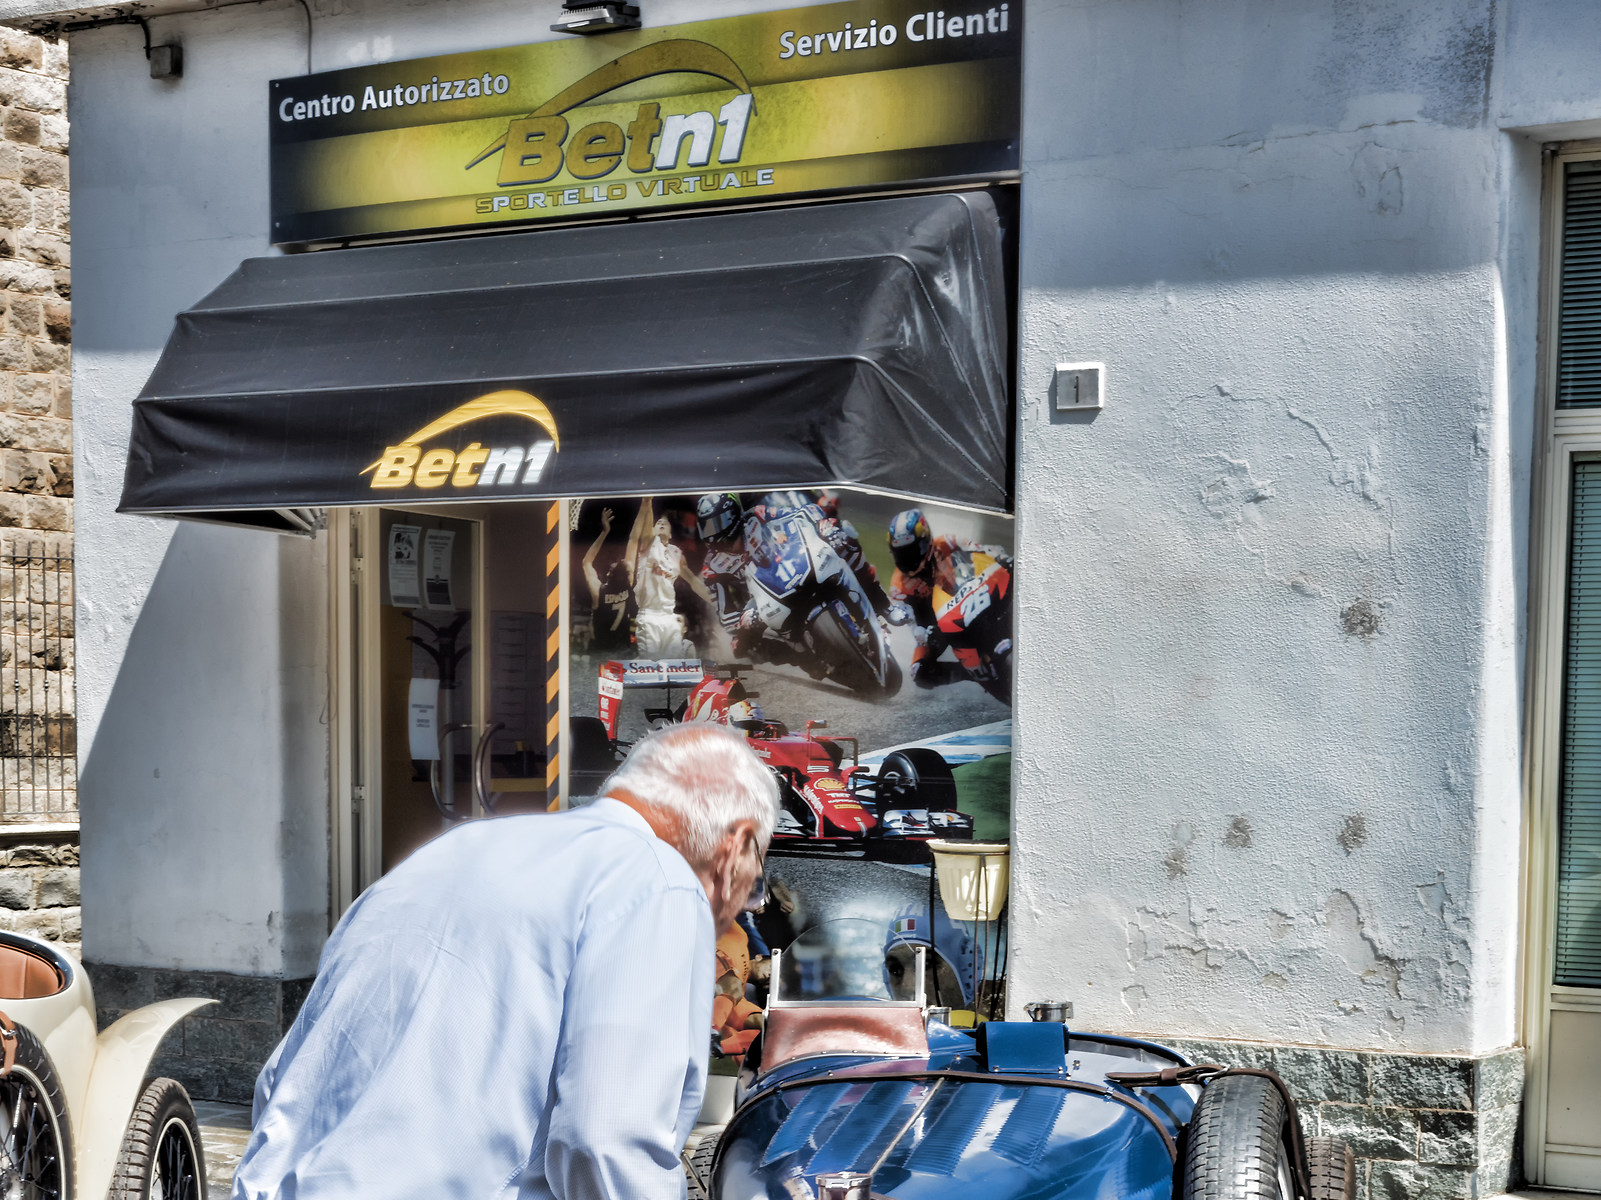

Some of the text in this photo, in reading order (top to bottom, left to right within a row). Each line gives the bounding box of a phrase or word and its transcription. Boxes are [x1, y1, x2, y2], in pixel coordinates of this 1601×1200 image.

[779, 3, 1009, 59] Servizio Clienti
[278, 72, 509, 122] Centro Autorizzato
[497, 93, 754, 187] Betn1
[475, 168, 775, 214] SPORTELLO VIRTUALE
[370, 439, 555, 488] Betn1
[609, 600, 626, 631] 7
[960, 583, 991, 628] 26
